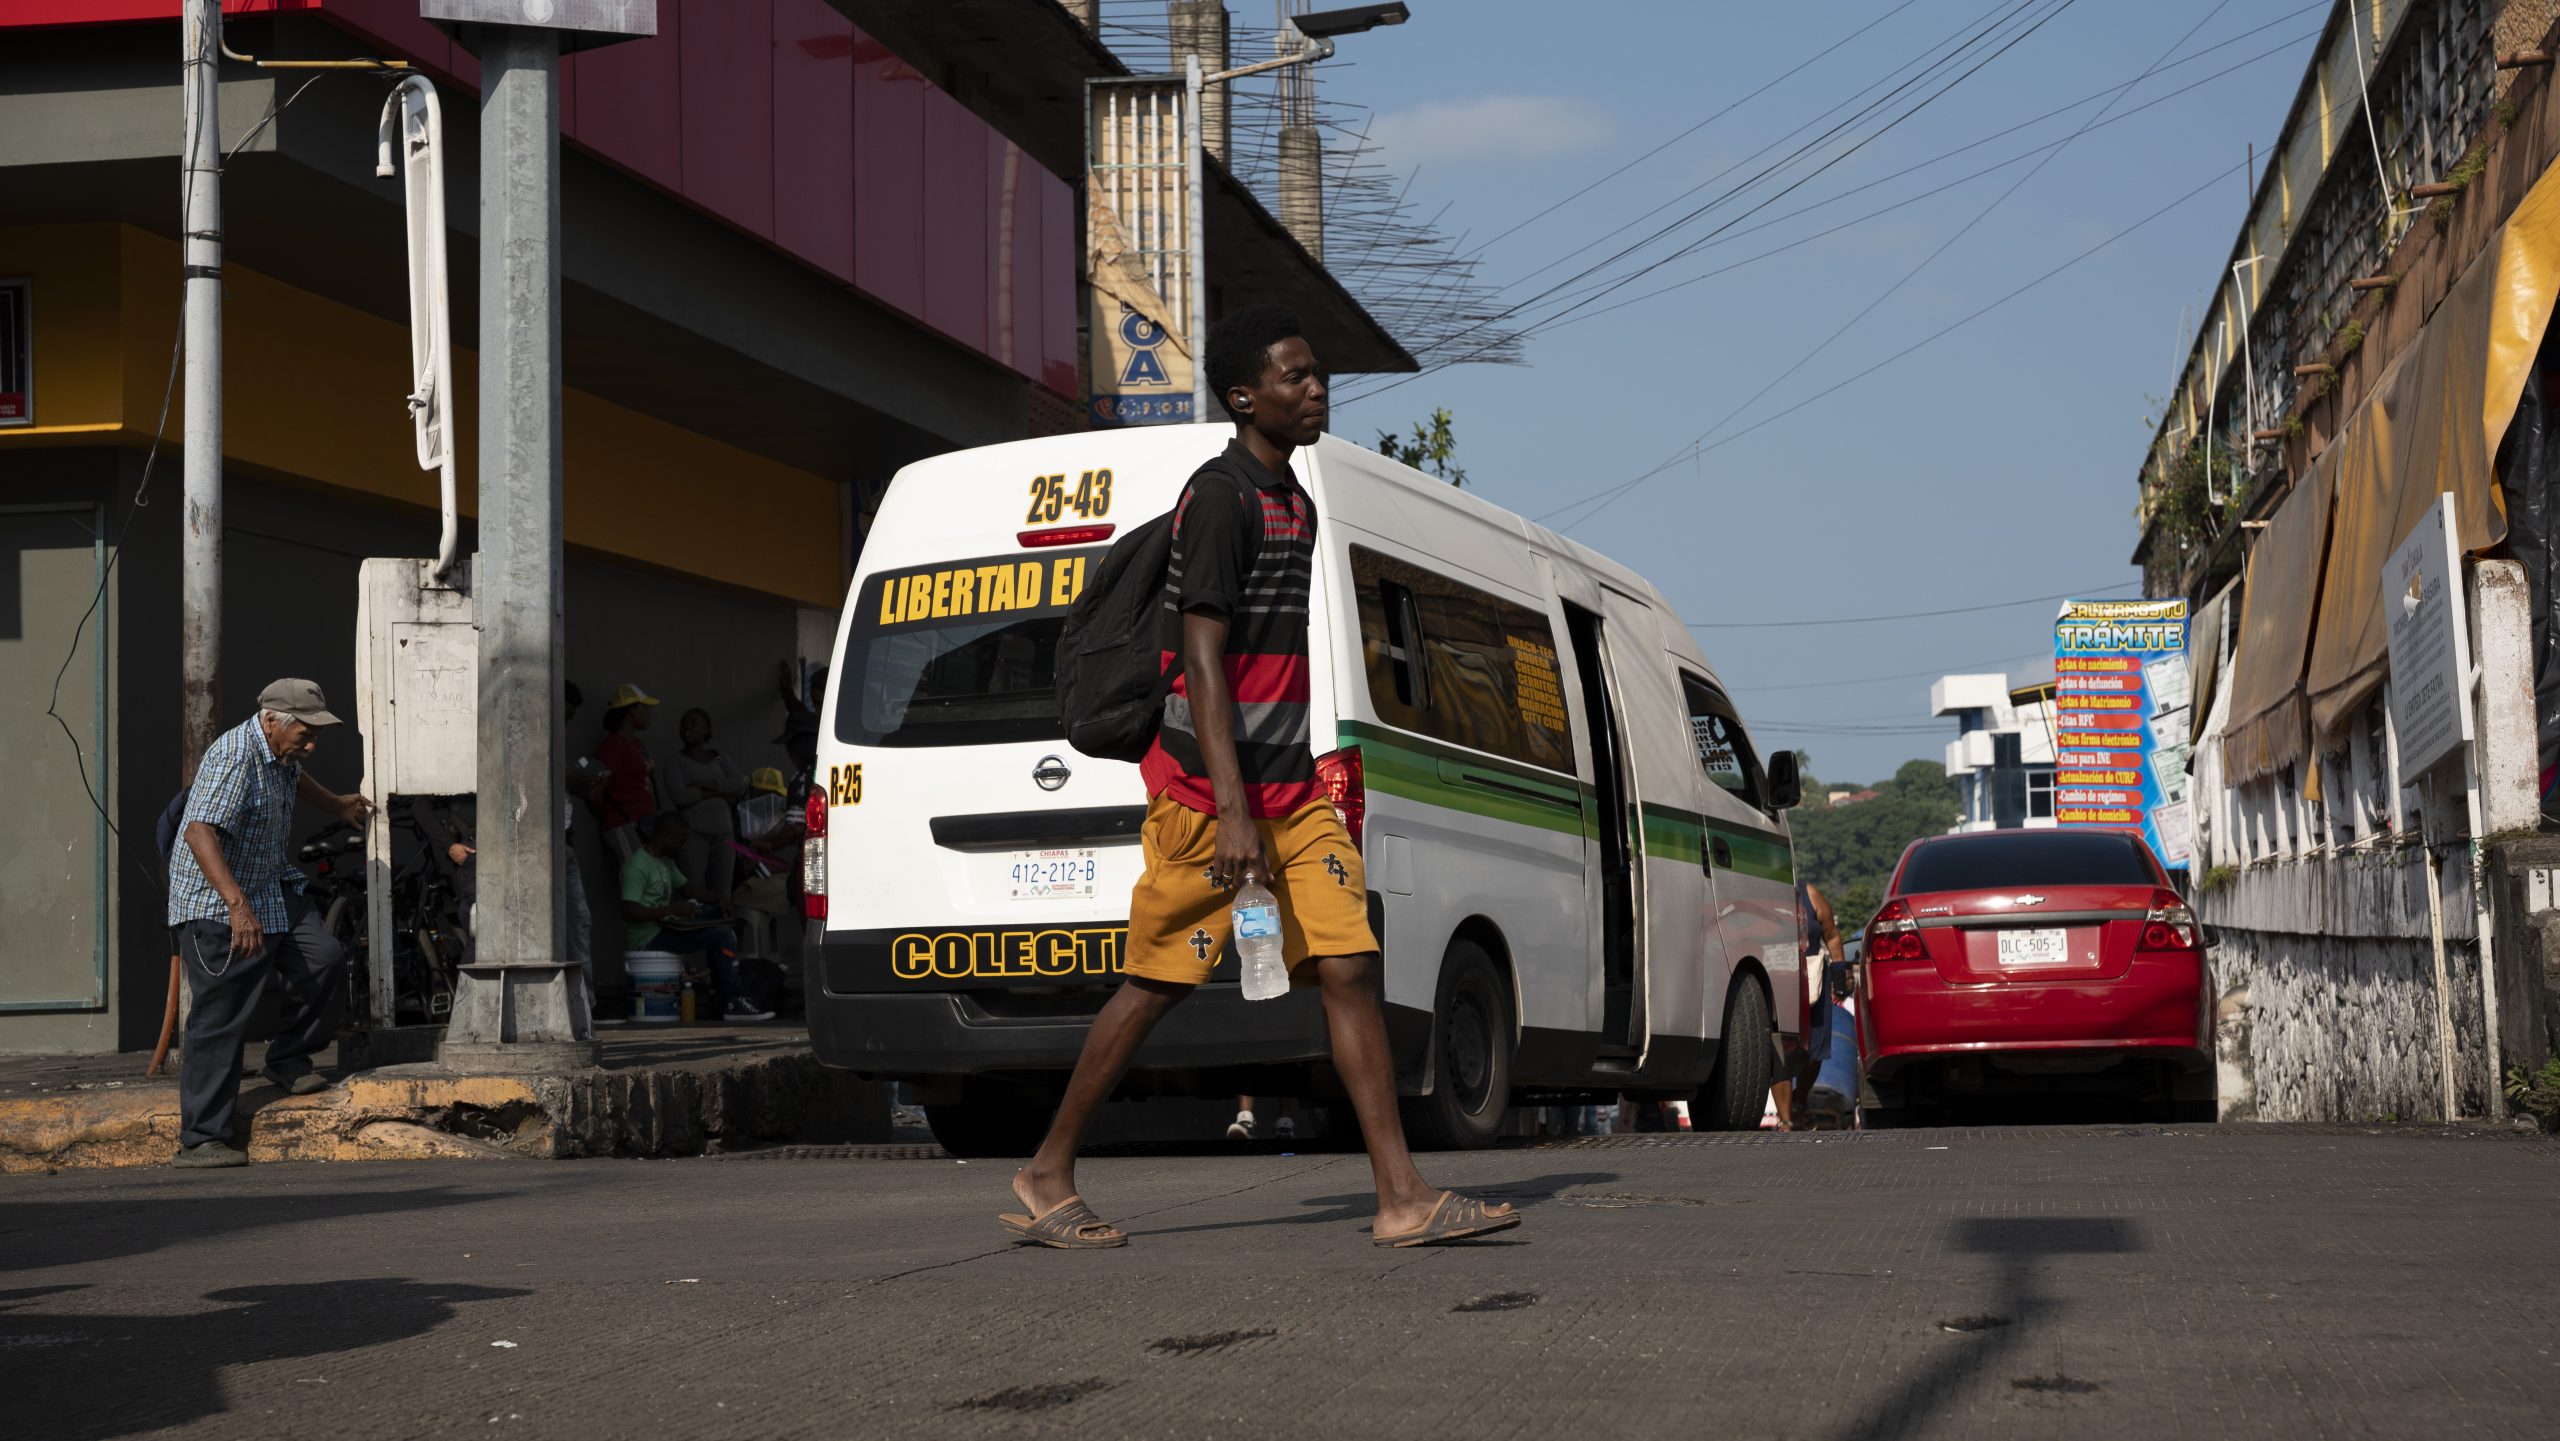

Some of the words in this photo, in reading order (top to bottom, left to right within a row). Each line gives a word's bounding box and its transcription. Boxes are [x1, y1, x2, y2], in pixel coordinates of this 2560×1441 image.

[1026, 468, 1113, 525] 25-43
[880, 562, 1043, 626] LIBERTAD
[2066, 602, 2162, 619] EALIZAMOS
[2059, 619, 2184, 651] TRÁMITE
[1515, 660, 1557, 683] CHEDRAUI
[2078, 658, 2087, 671] de
[2088, 658, 2128, 671] nacimiento
[1518, 672, 1559, 695] CERRITOS
[2079, 676, 2087, 689] de
[2088, 676, 2123, 690] defunción
[2079, 696, 2089, 709] de
[2090, 696, 2131, 709] Matrimonio
[1522, 710, 1542, 725] CITY
[1543, 715, 1565, 732] CLUB
[2078, 713, 2095, 727] RFC
[2081, 733, 2101, 746] firma
[2102, 733, 2140, 746] electrónica
[2079, 754, 2096, 767] para
[2096, 752, 2111, 765] INE
[830, 763, 862, 807] R-25
[2105, 771, 2114, 784] de
[2115, 771, 2136, 784] CURP
[2087, 790, 2096, 802] de
[2087, 808, 2096, 821] de
[2097, 808, 2131, 821] domicilio
[1012, 860, 1095, 883] 412-212-B
[2001, 938, 2064, 953] DLC-505-J
